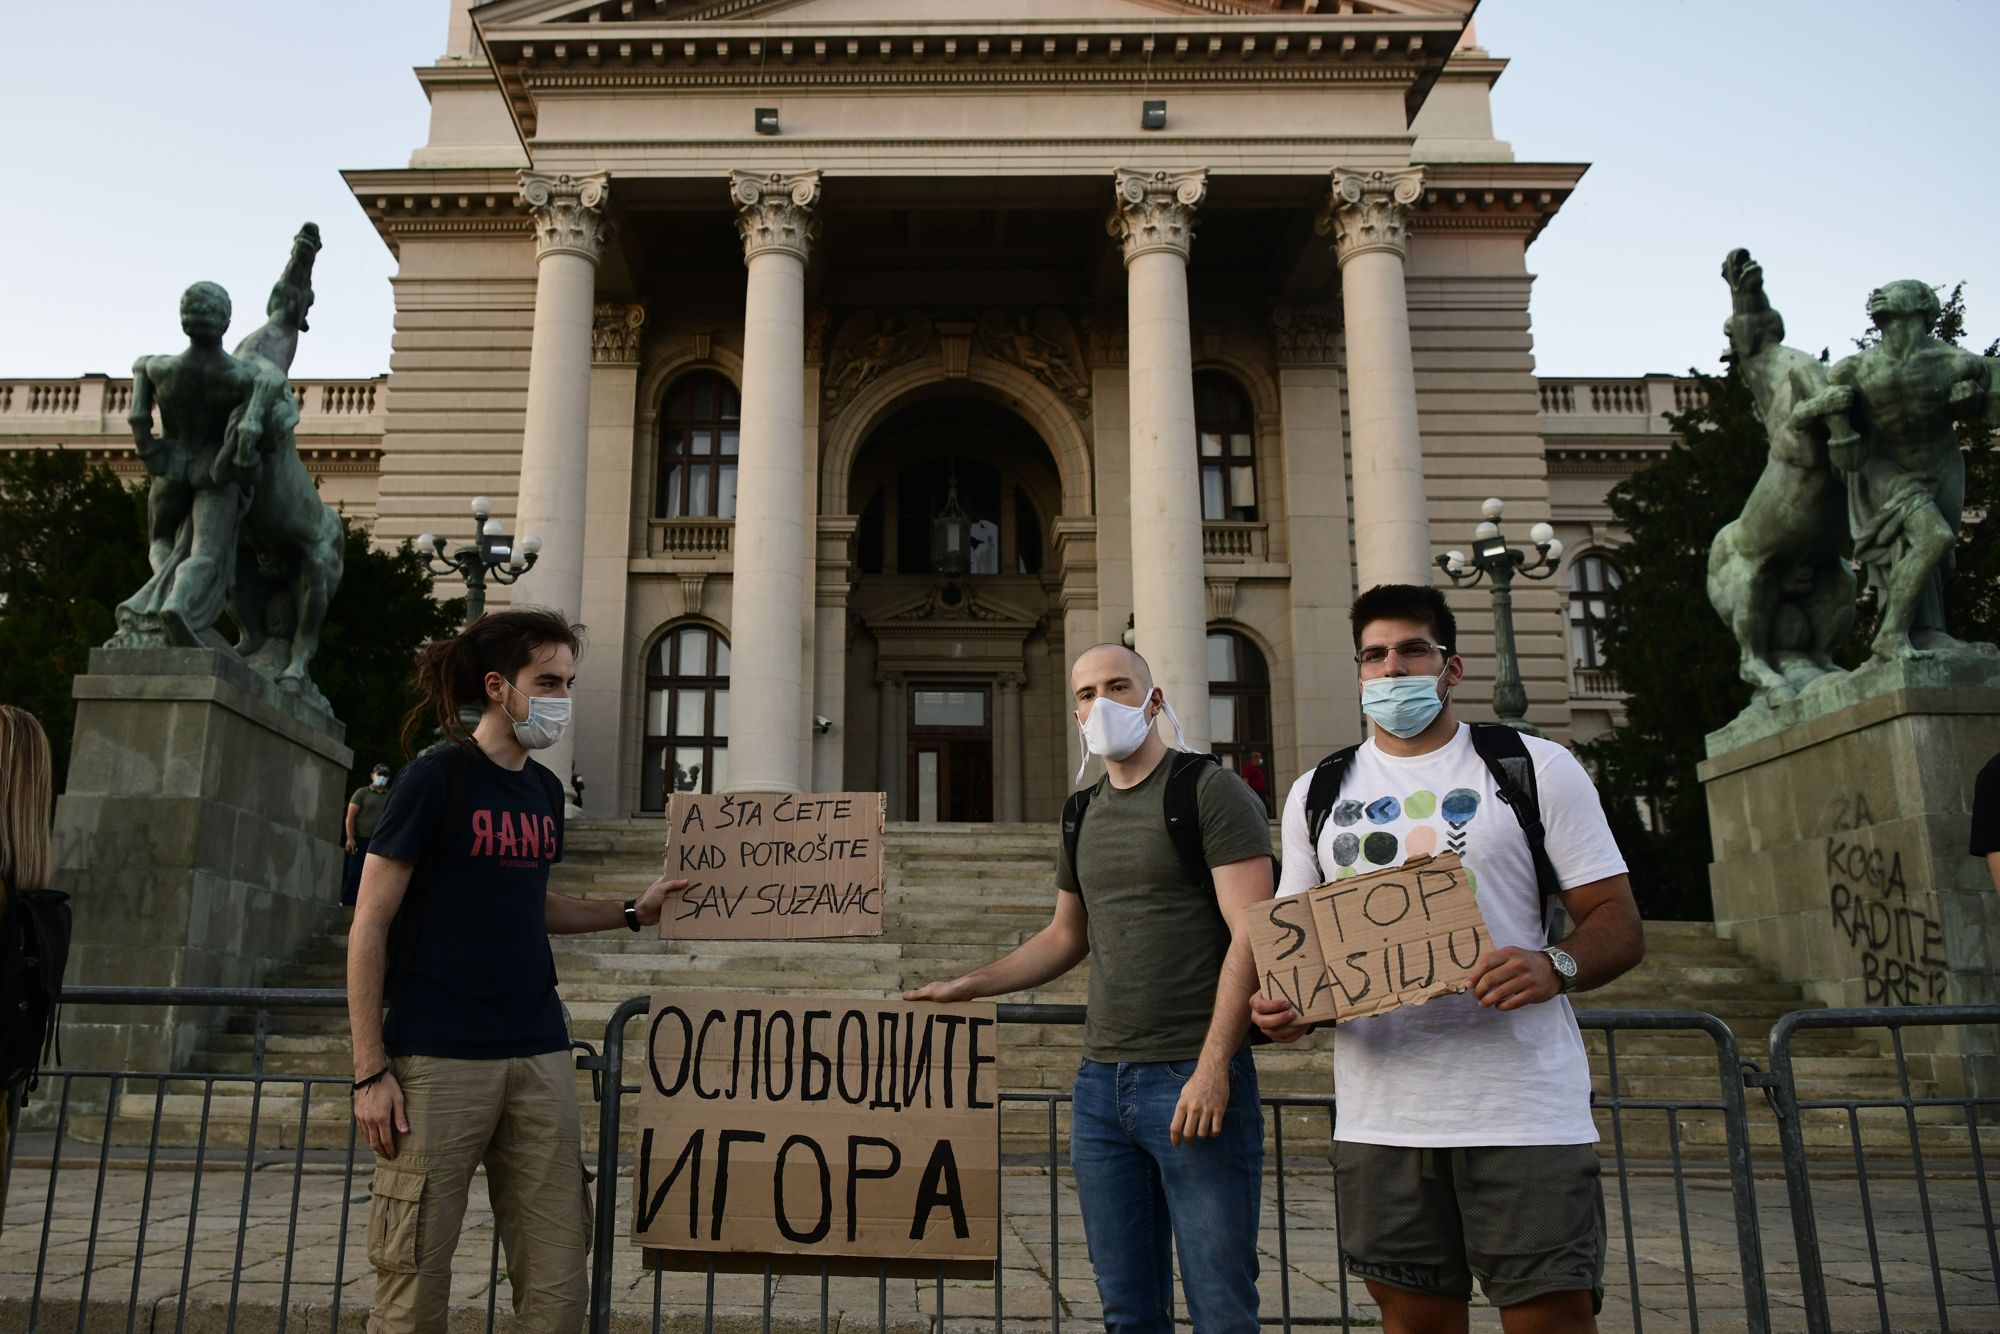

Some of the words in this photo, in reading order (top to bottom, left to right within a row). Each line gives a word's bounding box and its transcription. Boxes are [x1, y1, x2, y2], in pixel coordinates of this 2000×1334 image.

[680, 845, 726, 871] KAD
[741, 833, 869, 867] POTROŠITE
[682, 804, 704, 834] A
[715, 795, 762, 829] ŠTA
[773, 794, 852, 826] ĆETE
[675, 883, 748, 921] SAV
[752, 882, 880, 916] SUZAVAC
[1826, 836, 1908, 902] KOGA
[1269, 870, 1458, 960] STOP
[1830, 883, 1949, 968] RADITE
[1266, 927, 1481, 1017] NASILJU
[649, 1005, 996, 1113] ОСЛОБОДИТЕ
[636, 1127, 970, 1244] ИГОРА
